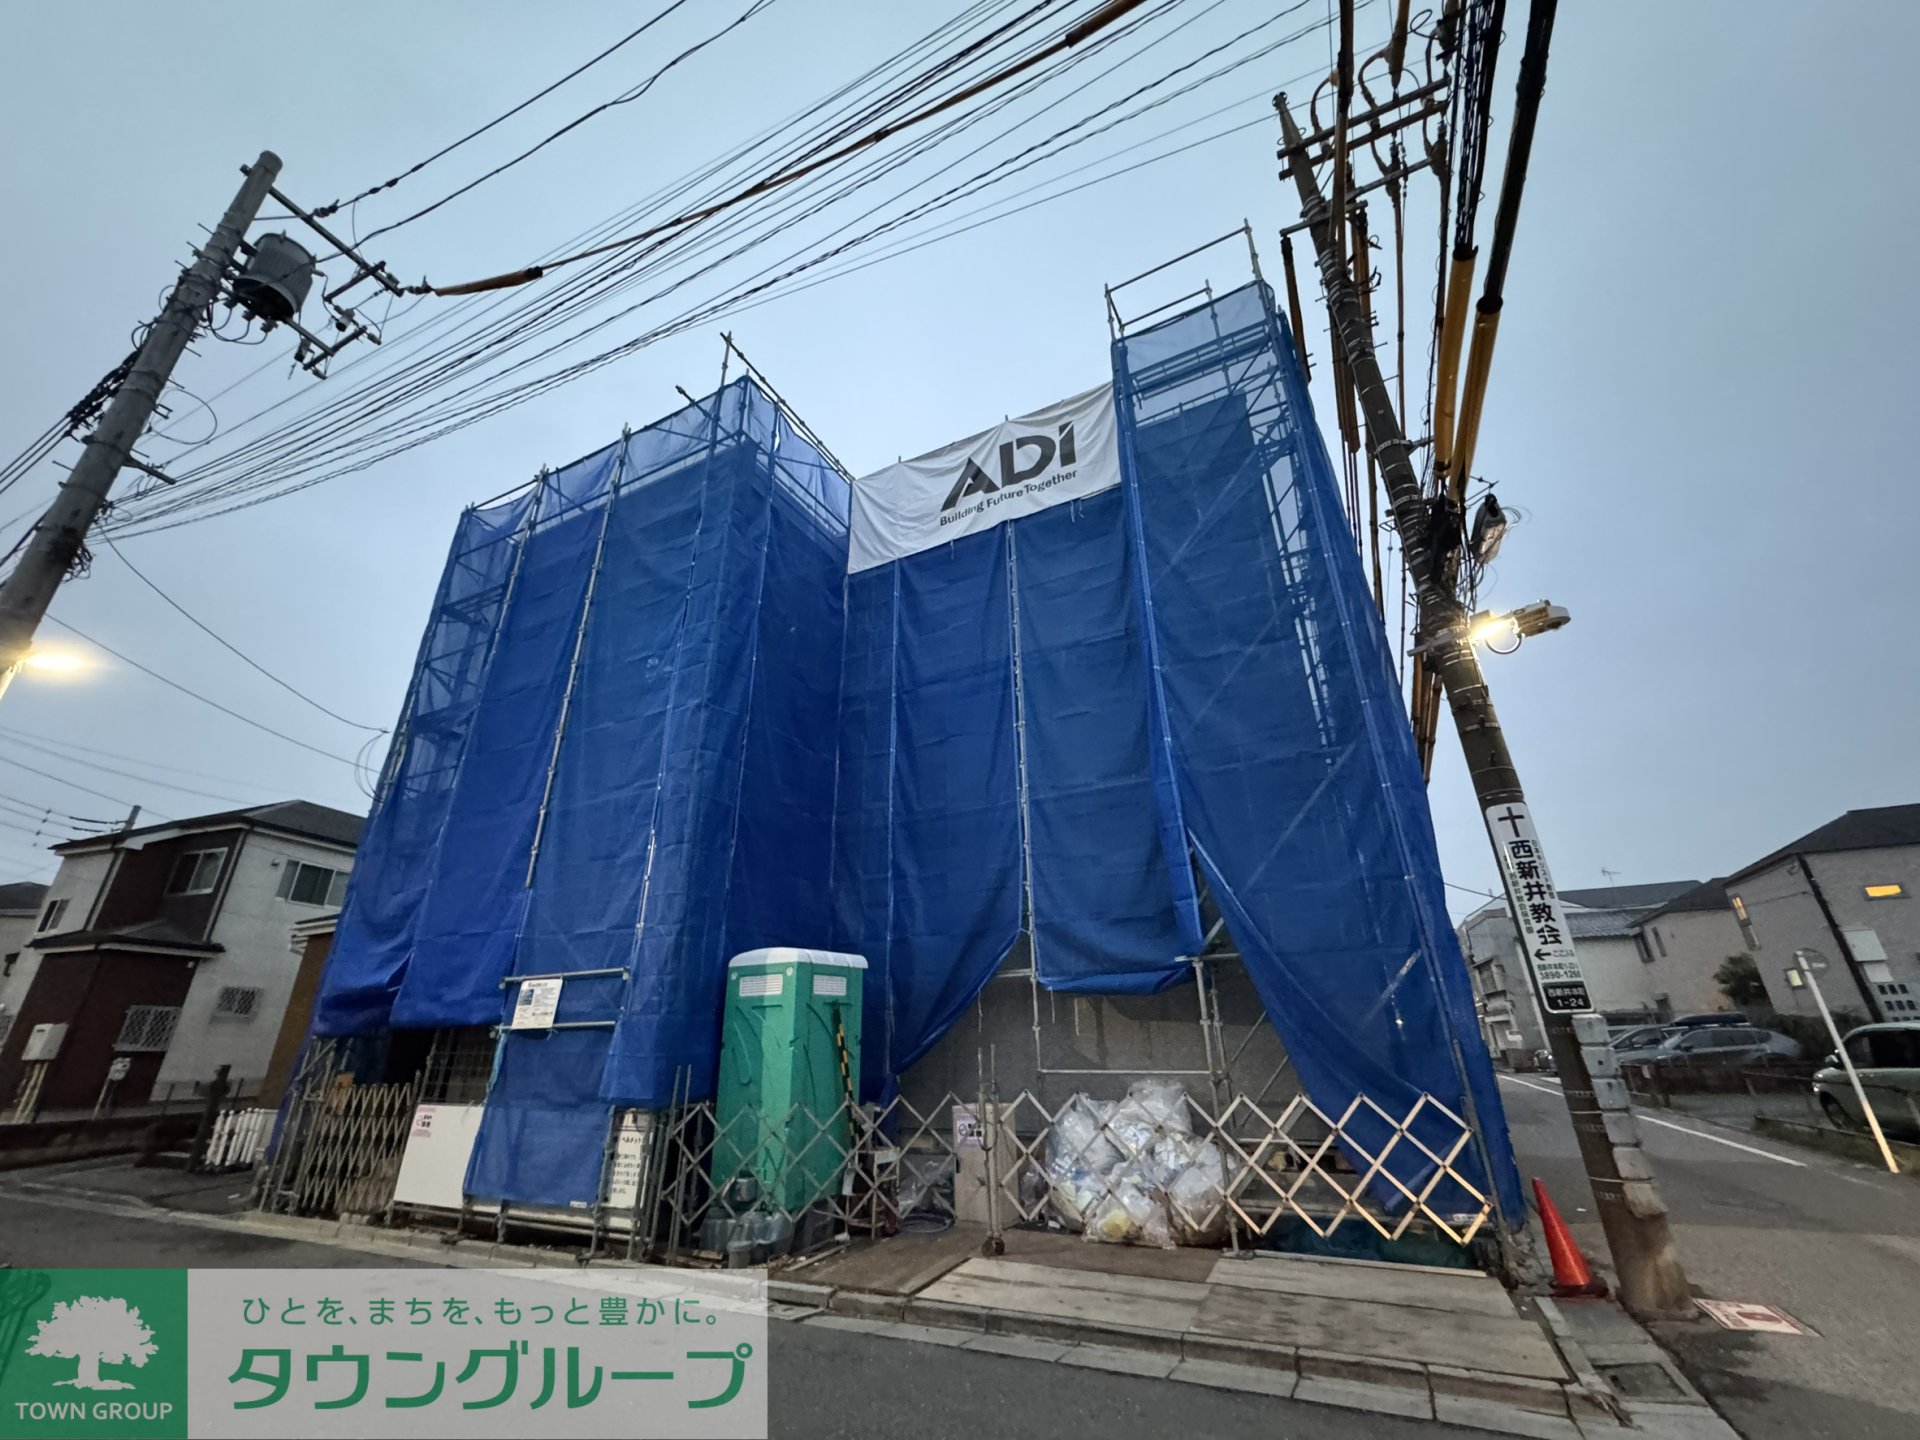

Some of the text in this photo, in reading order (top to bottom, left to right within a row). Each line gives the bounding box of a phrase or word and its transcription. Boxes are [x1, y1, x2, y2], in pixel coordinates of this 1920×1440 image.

[940, 470, 1077, 526] Building Future Together
[1508, 839, 1563, 946] 西新井教会
[1557, 998, 1585, 1008] 1-24
